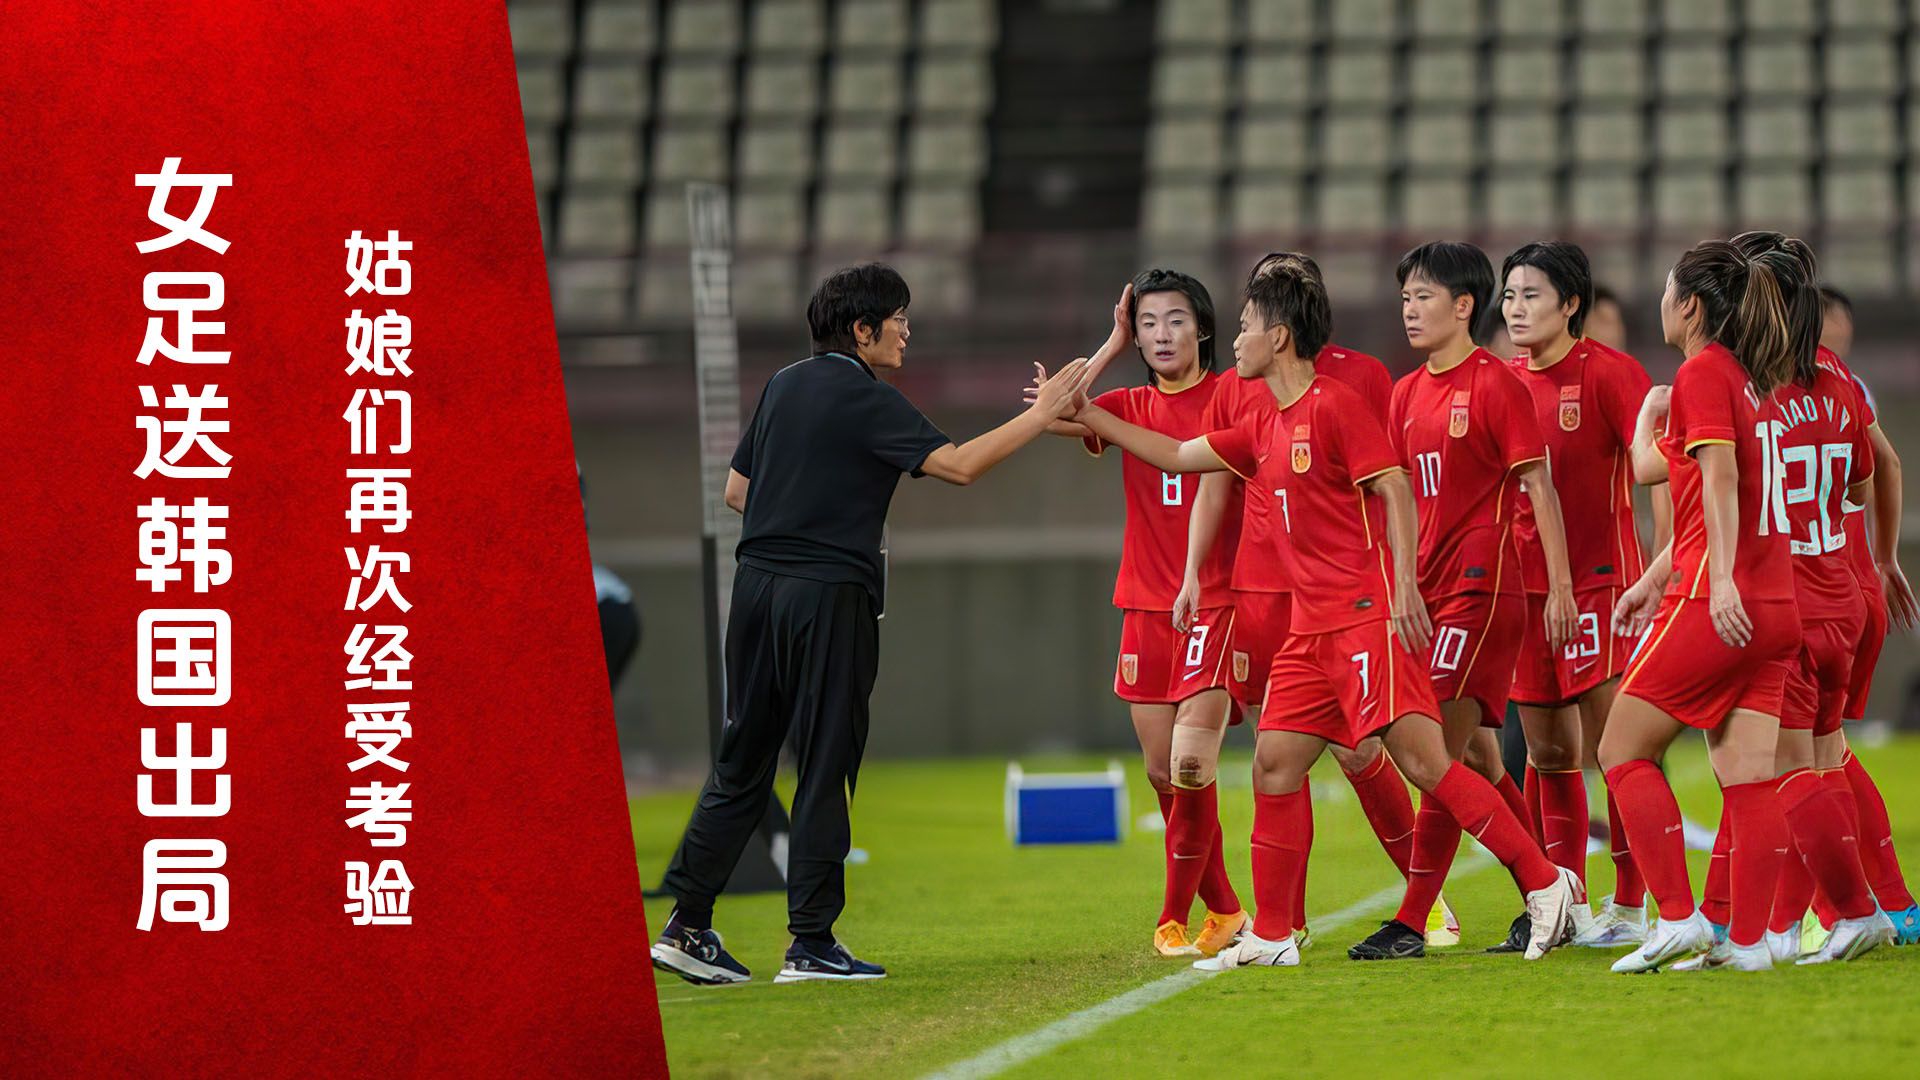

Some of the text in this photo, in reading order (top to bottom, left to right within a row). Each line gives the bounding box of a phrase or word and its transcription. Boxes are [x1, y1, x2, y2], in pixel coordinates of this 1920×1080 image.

[1416, 451, 1442, 498] 10
[1185, 625, 1210, 666] 8
[1430, 625, 1469, 671] 10
[1351, 651, 1370, 700] 7
